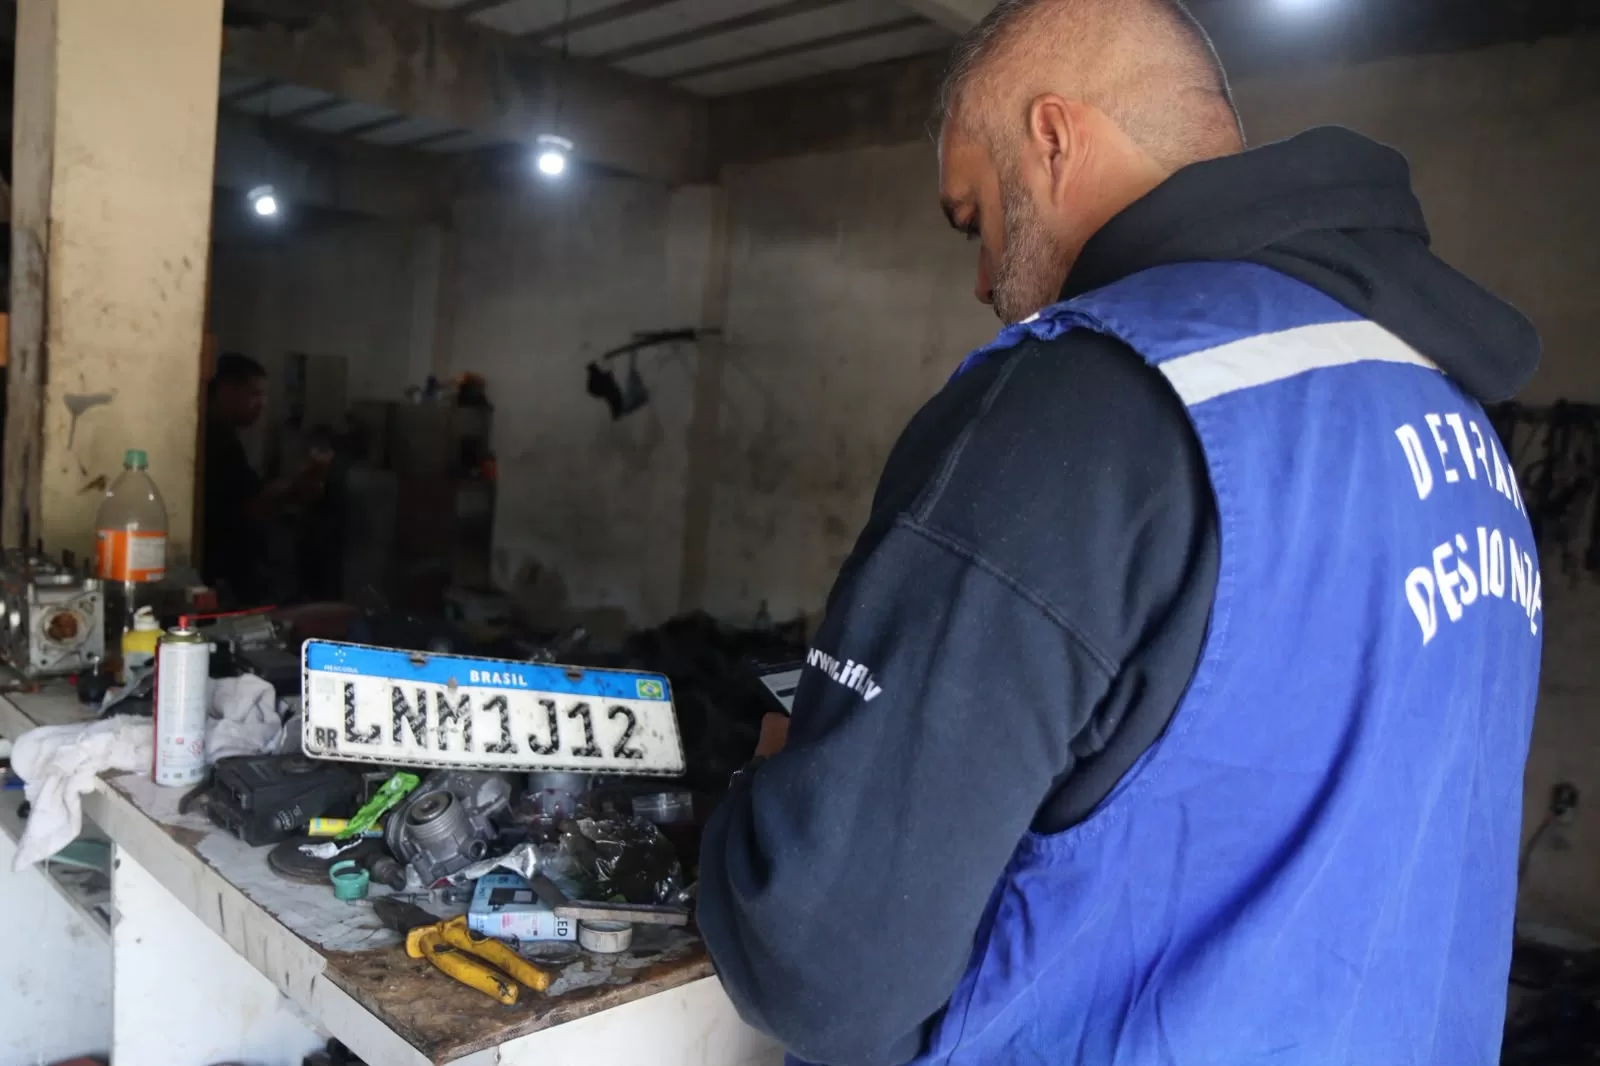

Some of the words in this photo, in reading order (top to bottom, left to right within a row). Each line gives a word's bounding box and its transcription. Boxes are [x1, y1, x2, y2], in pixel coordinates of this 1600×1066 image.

[470, 669, 528, 687] BRASIL
[343, 682, 643, 760] LNM1J12
[315, 726, 338, 750] BR
[557, 917, 569, 937] ED
